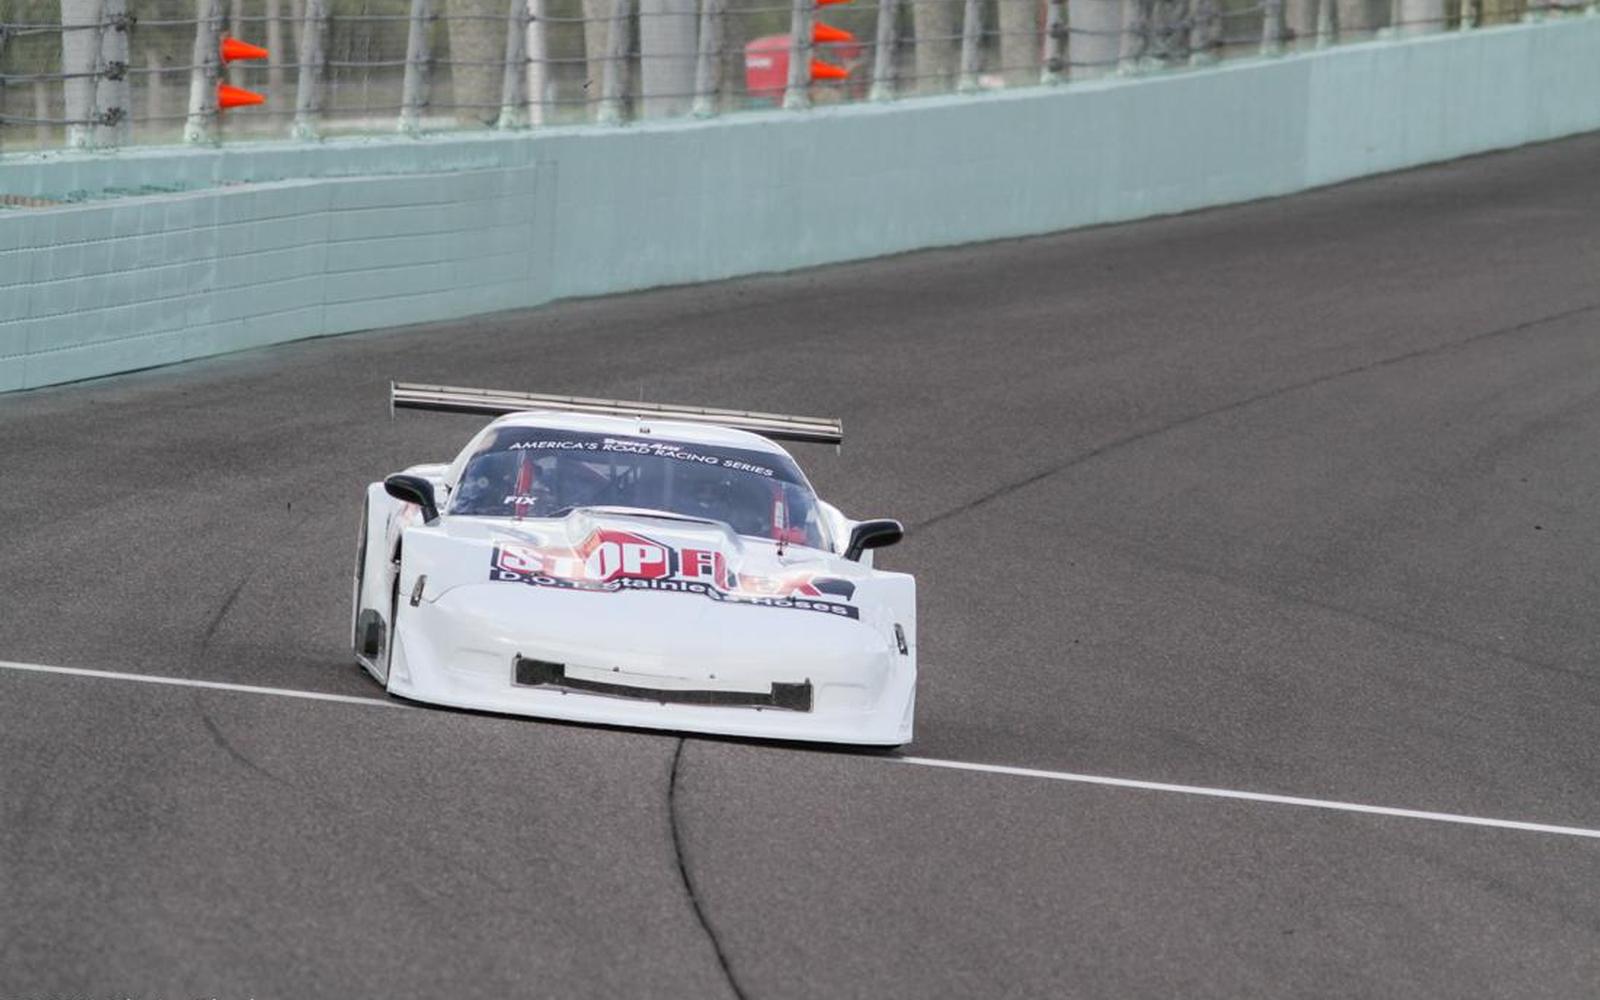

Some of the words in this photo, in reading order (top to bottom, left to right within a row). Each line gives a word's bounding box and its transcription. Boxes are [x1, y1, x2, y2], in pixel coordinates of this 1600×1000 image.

[509, 440, 598, 451] AMERICA'S
[603, 444, 650, 455] ROAD
[655, 449, 718, 465] RACING
[723, 460, 774, 477] SERIES
[503, 495, 537, 505] FIX
